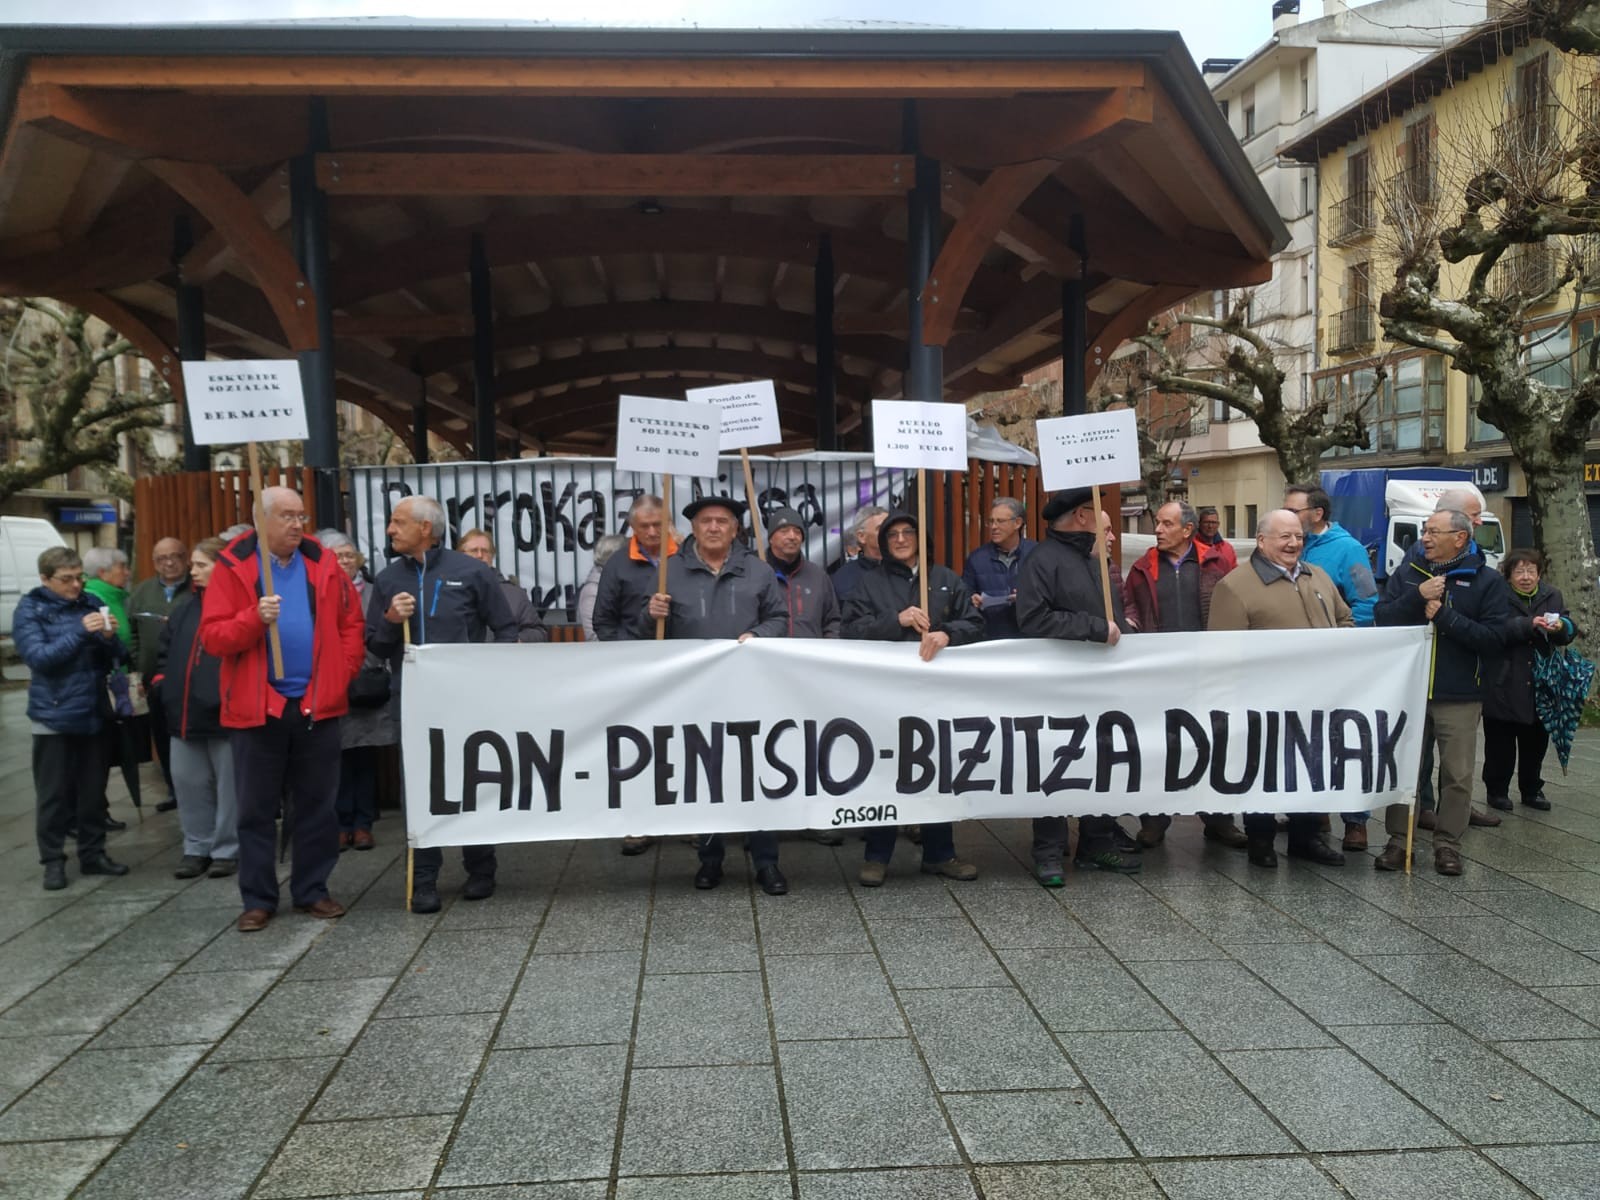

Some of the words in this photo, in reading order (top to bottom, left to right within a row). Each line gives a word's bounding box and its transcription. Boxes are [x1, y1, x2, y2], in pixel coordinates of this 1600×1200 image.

[208, 374, 278, 382] ESKUBIDE
[208, 384, 280, 392] SOZIALAK
[708, 395, 742, 403] Fondo
[204, 408, 292, 420] BERMATU
[667, 448, 699, 457] EURO
[1066, 453, 1116, 465] DUINAK
[430, 728, 563, 815] LAN
[1165, 708, 1408, 795] DUINAK
[832, 804, 897, 825] SASOIA
